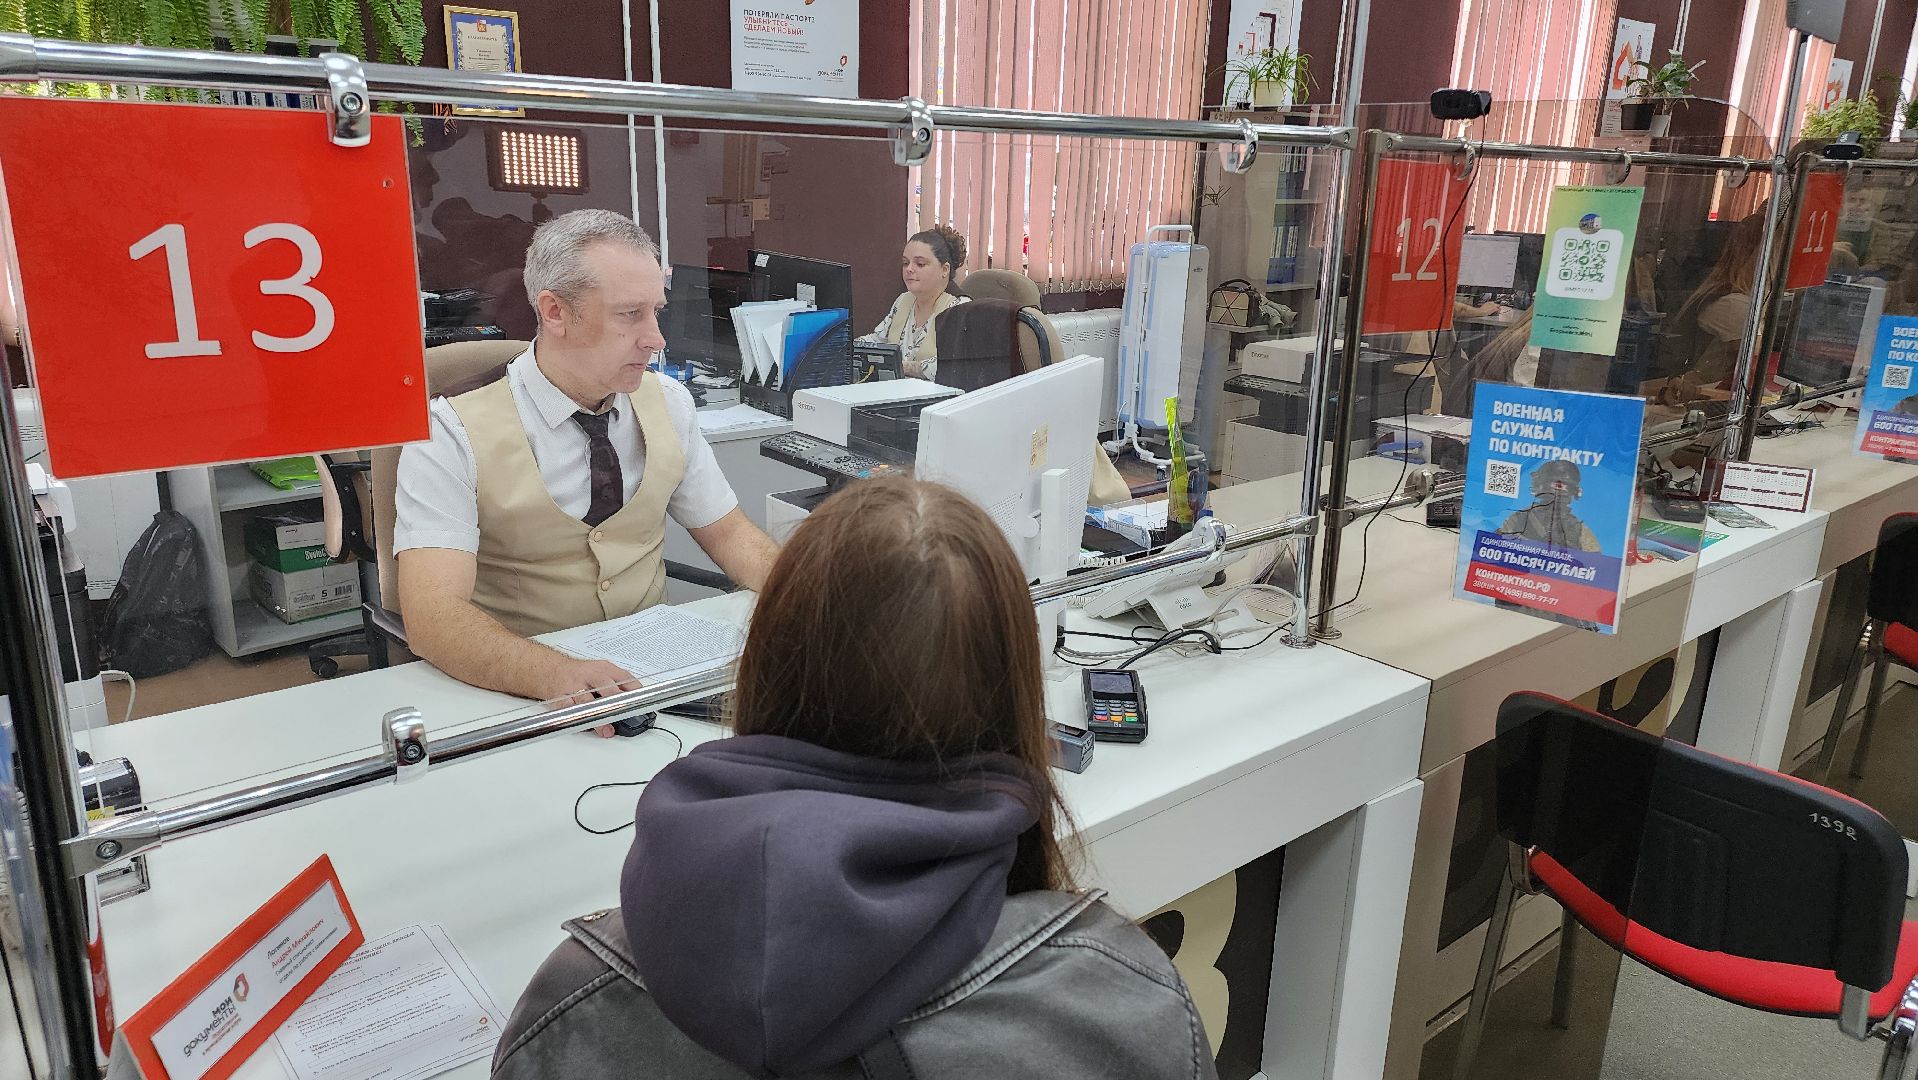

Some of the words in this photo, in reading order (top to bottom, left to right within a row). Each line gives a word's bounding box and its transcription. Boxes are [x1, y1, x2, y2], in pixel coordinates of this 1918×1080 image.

[1802, 210, 1828, 254] 11
[1391, 217, 1441, 281] 12
[129, 222, 335, 359] 13
[1493, 400, 1565, 423] ВОЕННАЯ
[1491, 420, 1555, 442] СЛУЖБА
[1488, 437, 1510, 453] ПО
[1511, 442, 1604, 467] КОНТРАКТУ
[1481, 537, 1540, 554] ЕДИНОВРЕМЕННАЯ
[1479, 546, 1502, 561] 600
[1503, 551, 1546, 571] ТЫСЯЧ
[1547, 559, 1597, 581] РУБЛЕЙ
[1475, 568, 1551, 593] КОНТРАКТМО.РФ
[1809, 812, 1857, 840] 1392
